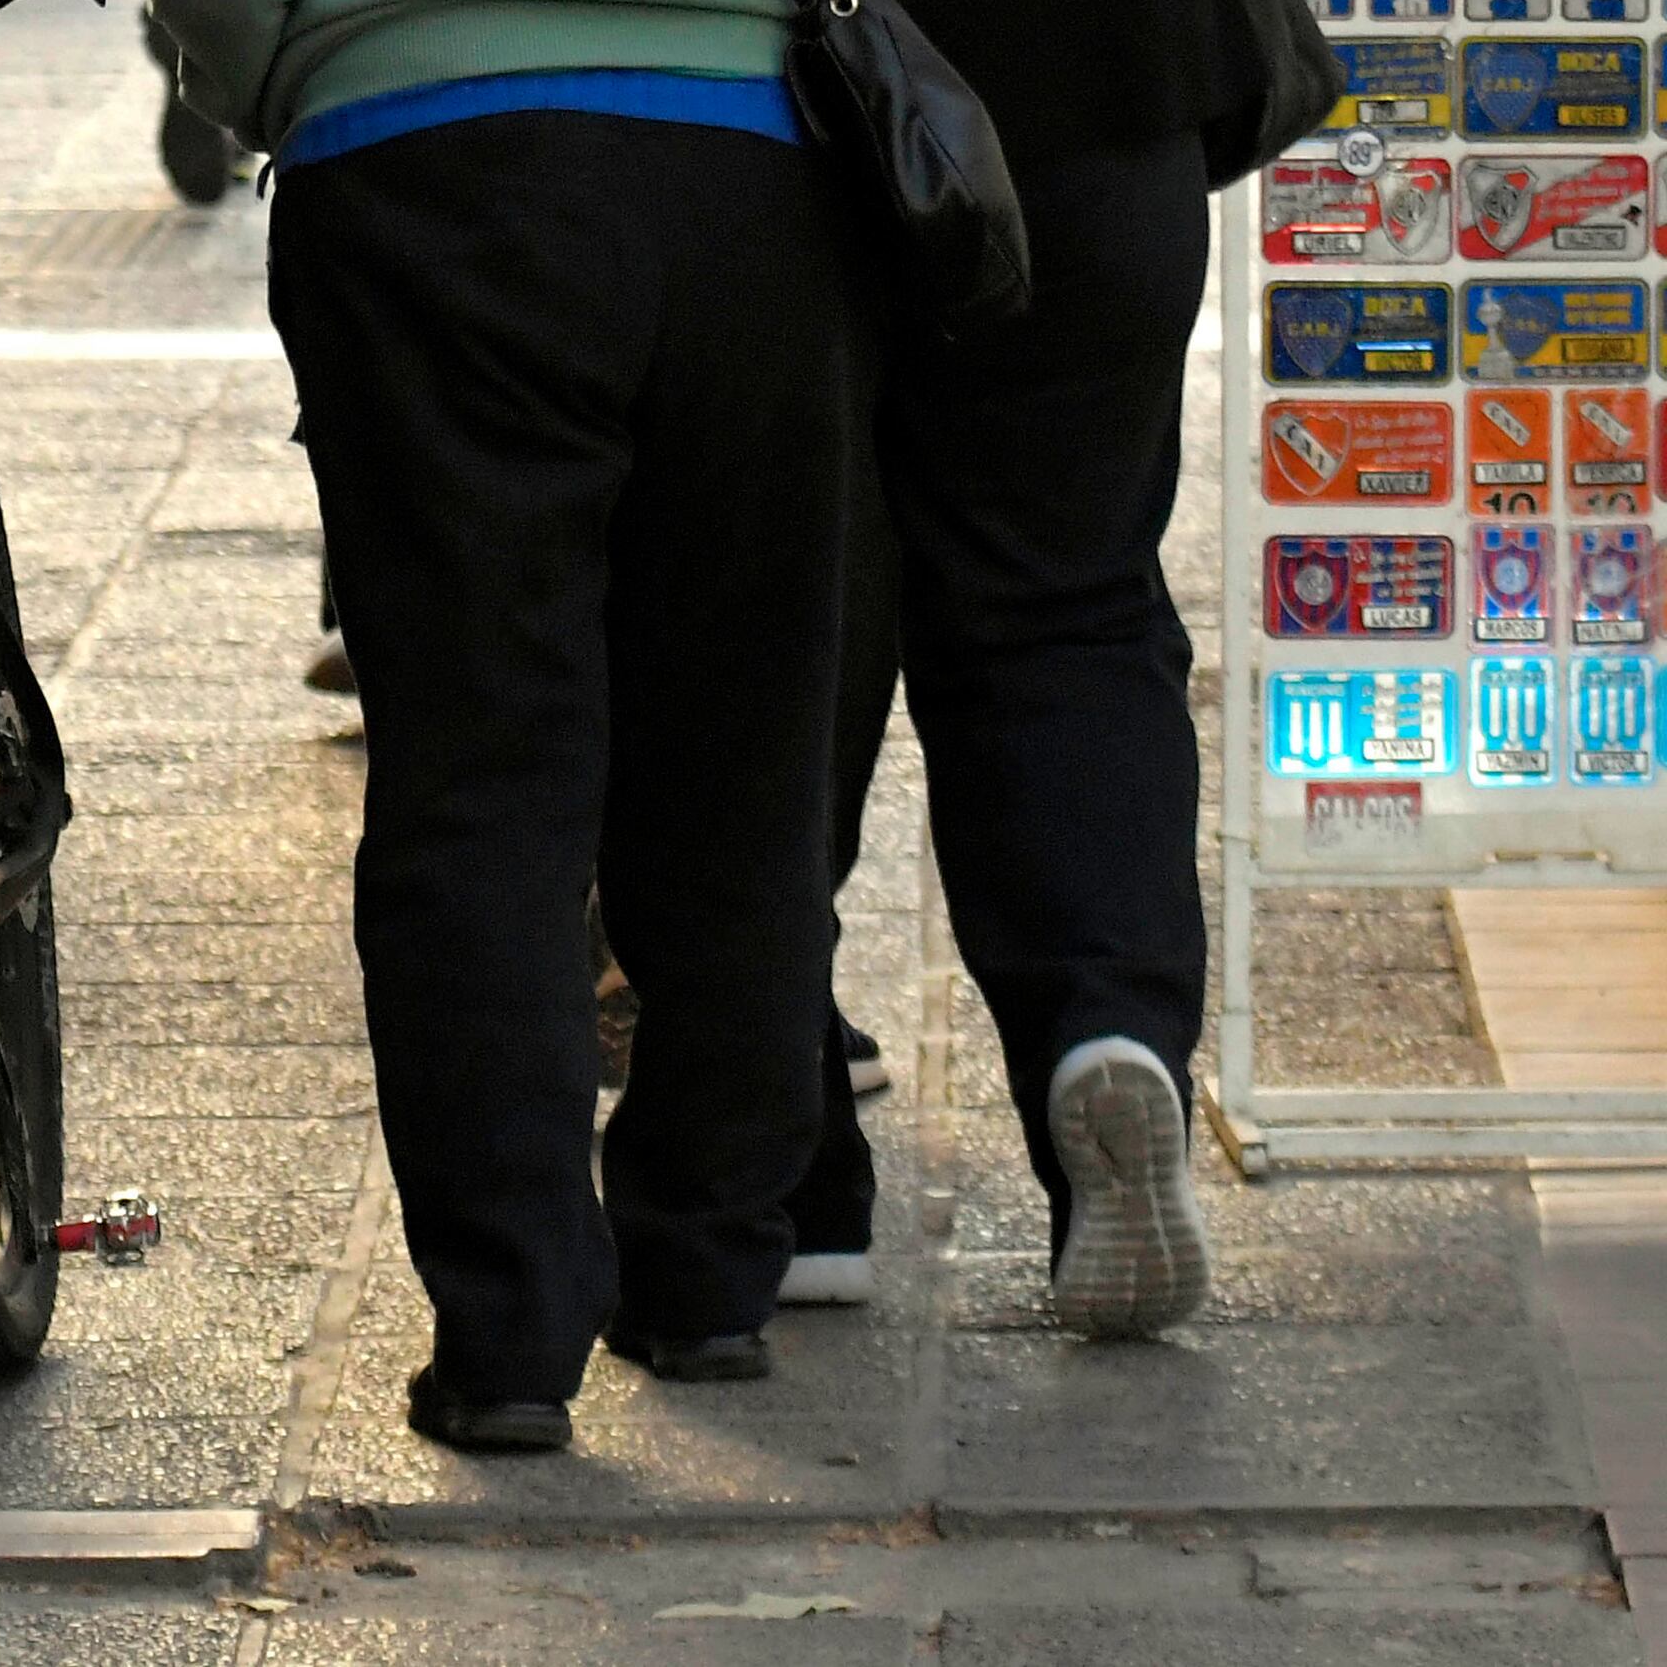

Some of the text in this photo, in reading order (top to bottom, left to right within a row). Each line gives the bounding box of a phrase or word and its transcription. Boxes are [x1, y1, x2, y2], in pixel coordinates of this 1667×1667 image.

[1364, 474, 1426, 493] XAVIER
[1370, 607, 1423, 628] LUCAS
[1371, 739, 1427, 757] YANINA
